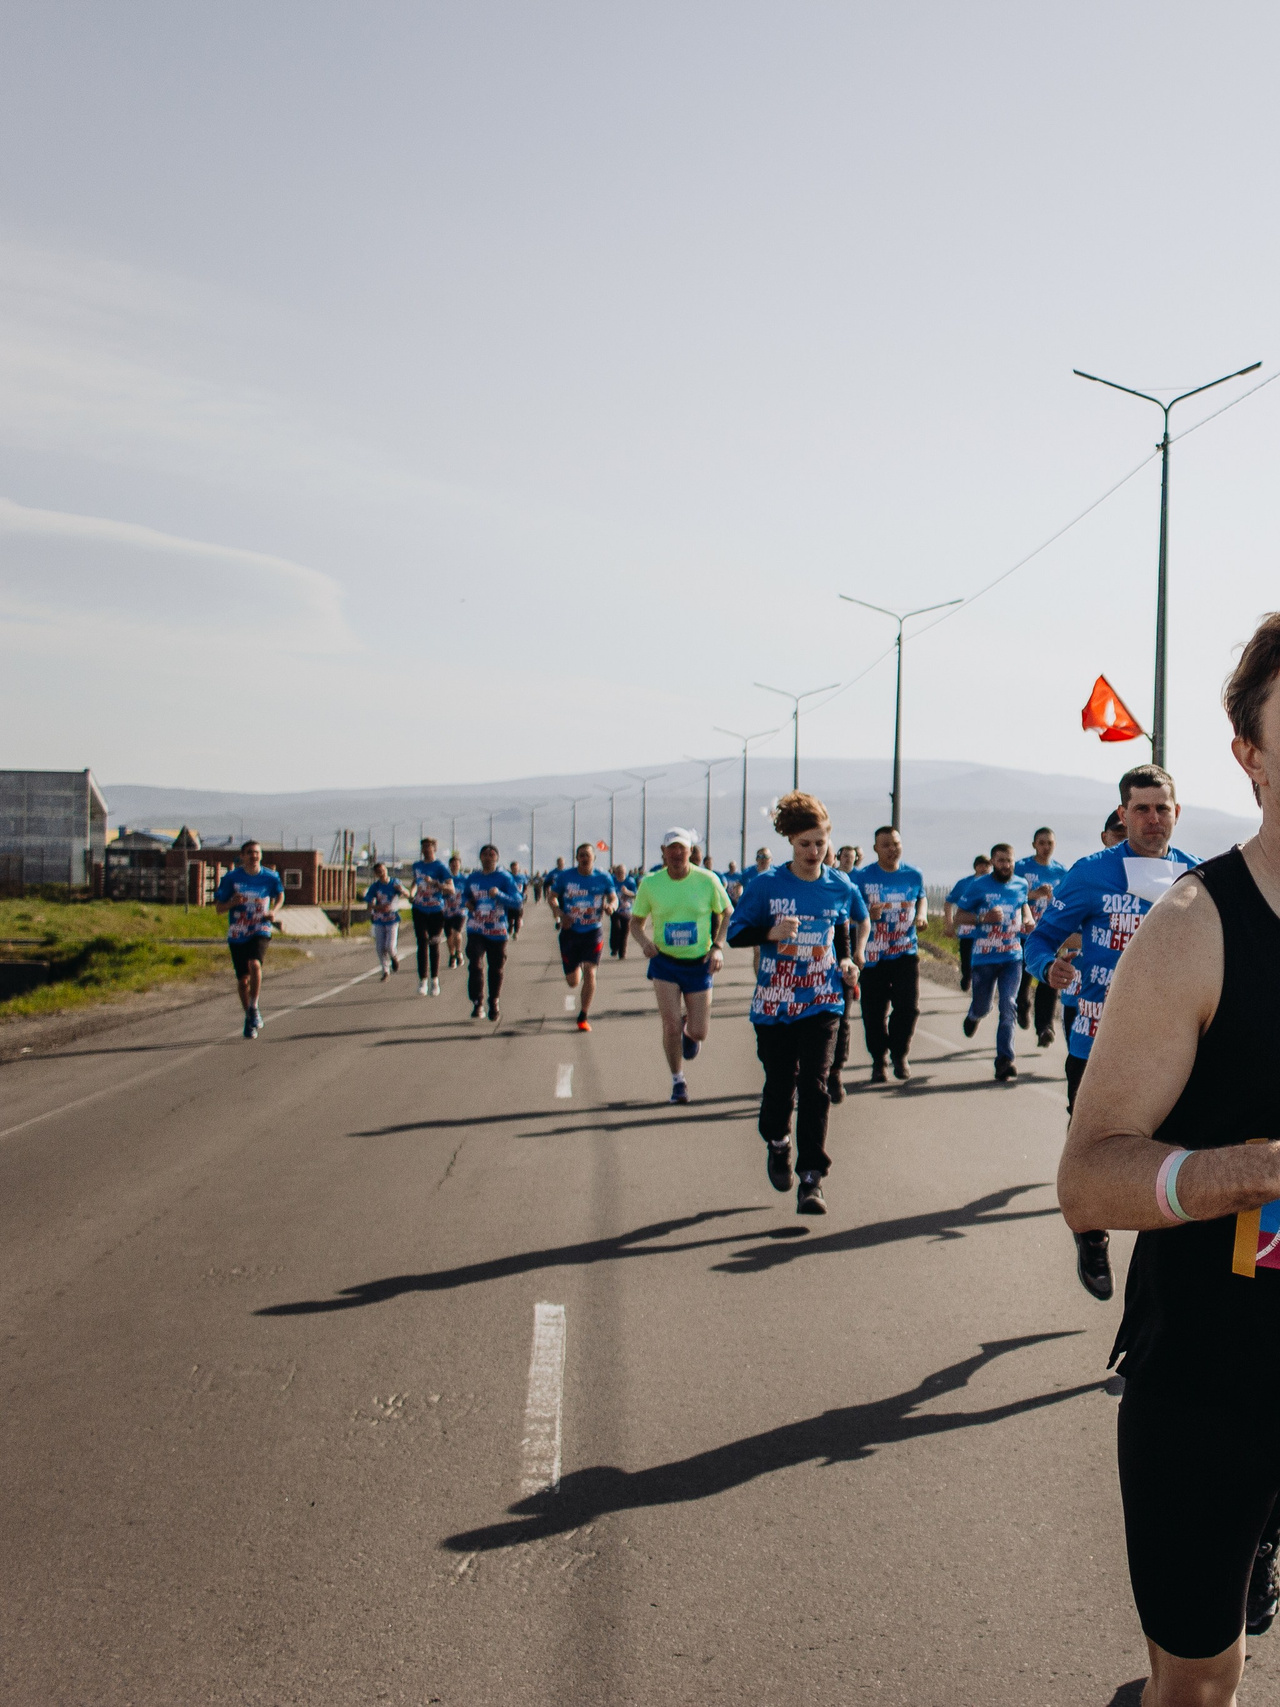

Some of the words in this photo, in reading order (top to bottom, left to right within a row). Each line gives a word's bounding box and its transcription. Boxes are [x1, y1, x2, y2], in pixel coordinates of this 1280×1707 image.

[770, 898, 797, 915] 2024
[1103, 894, 1141, 914] 2024
[1109, 913, 1147, 932] #МЕ
